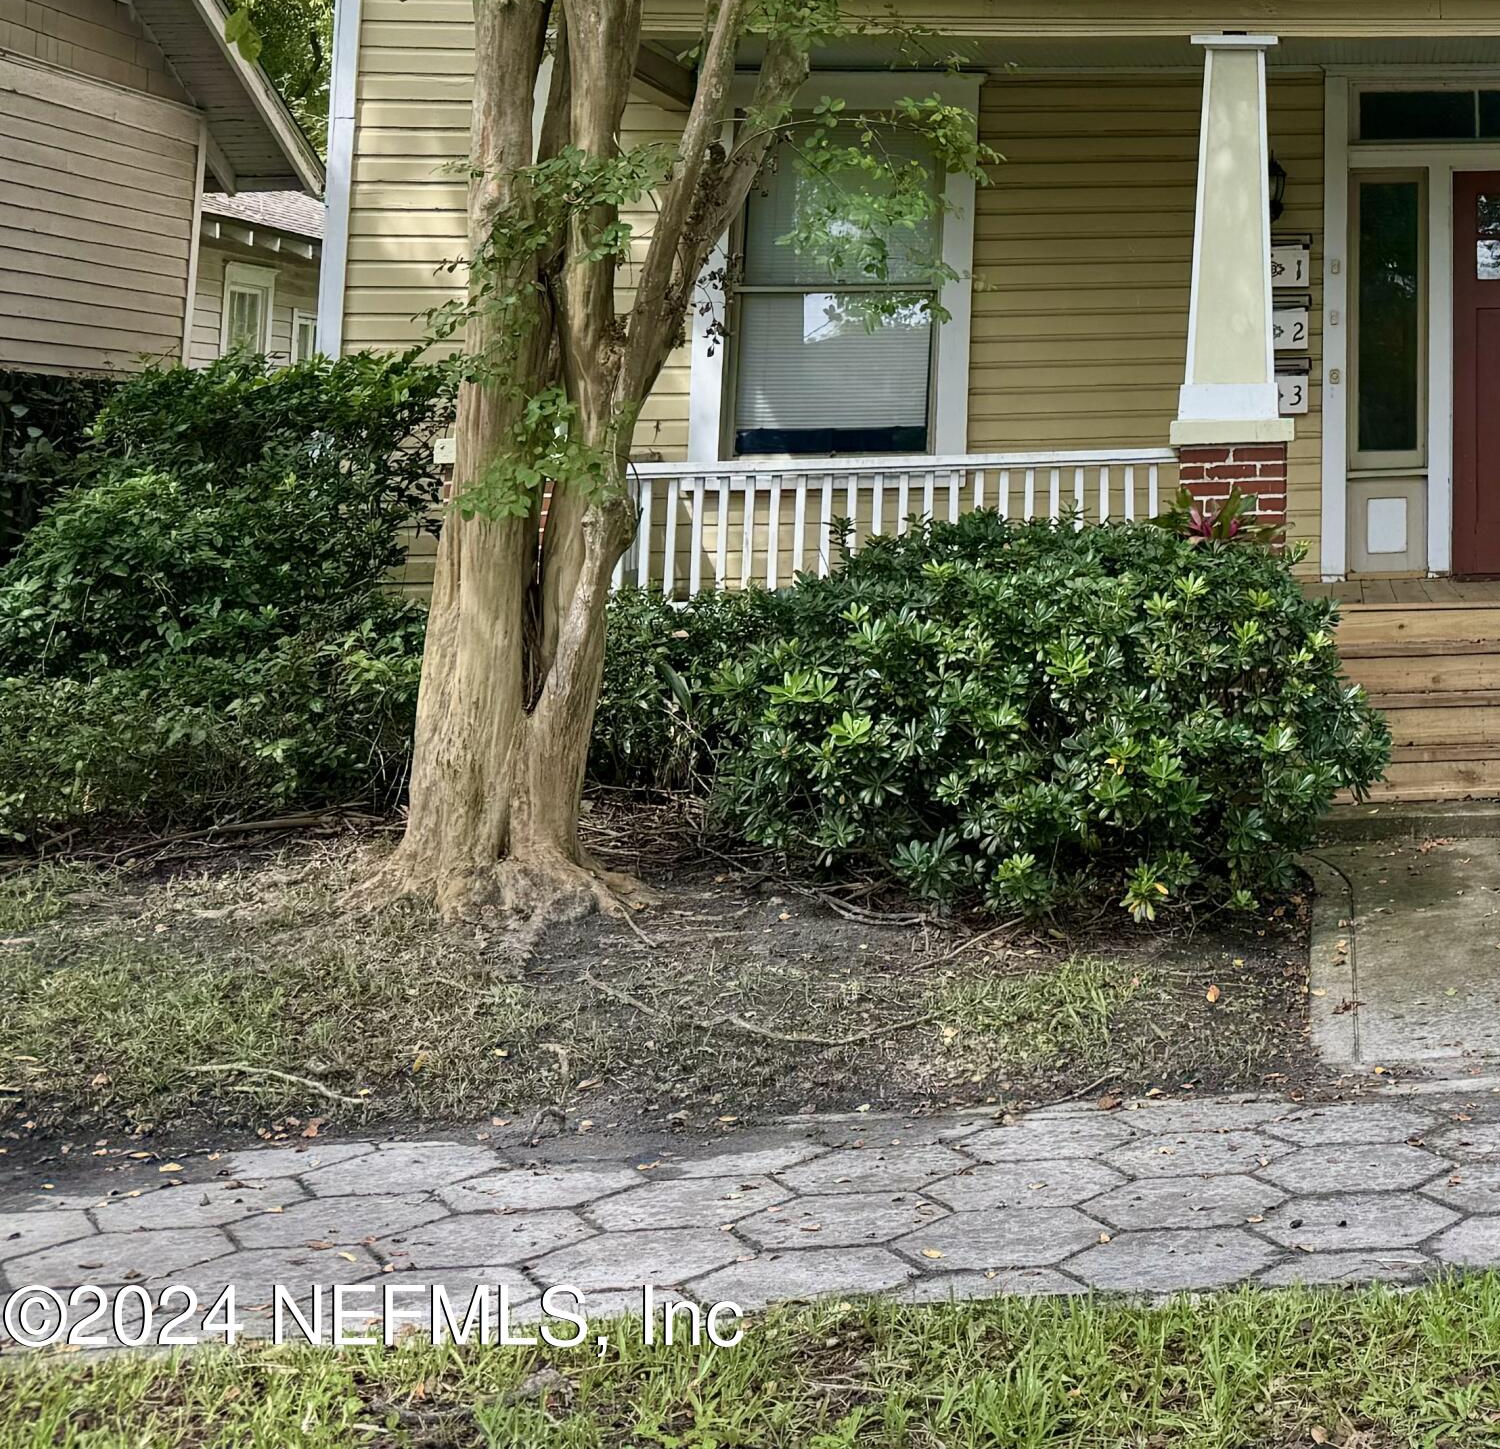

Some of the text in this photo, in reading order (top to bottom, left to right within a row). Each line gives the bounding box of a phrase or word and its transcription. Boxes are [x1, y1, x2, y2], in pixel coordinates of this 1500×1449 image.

[1296, 259, 1303, 281] 1
[1292, 322, 1305, 342] 2
[1289, 385, 1302, 406] 3
